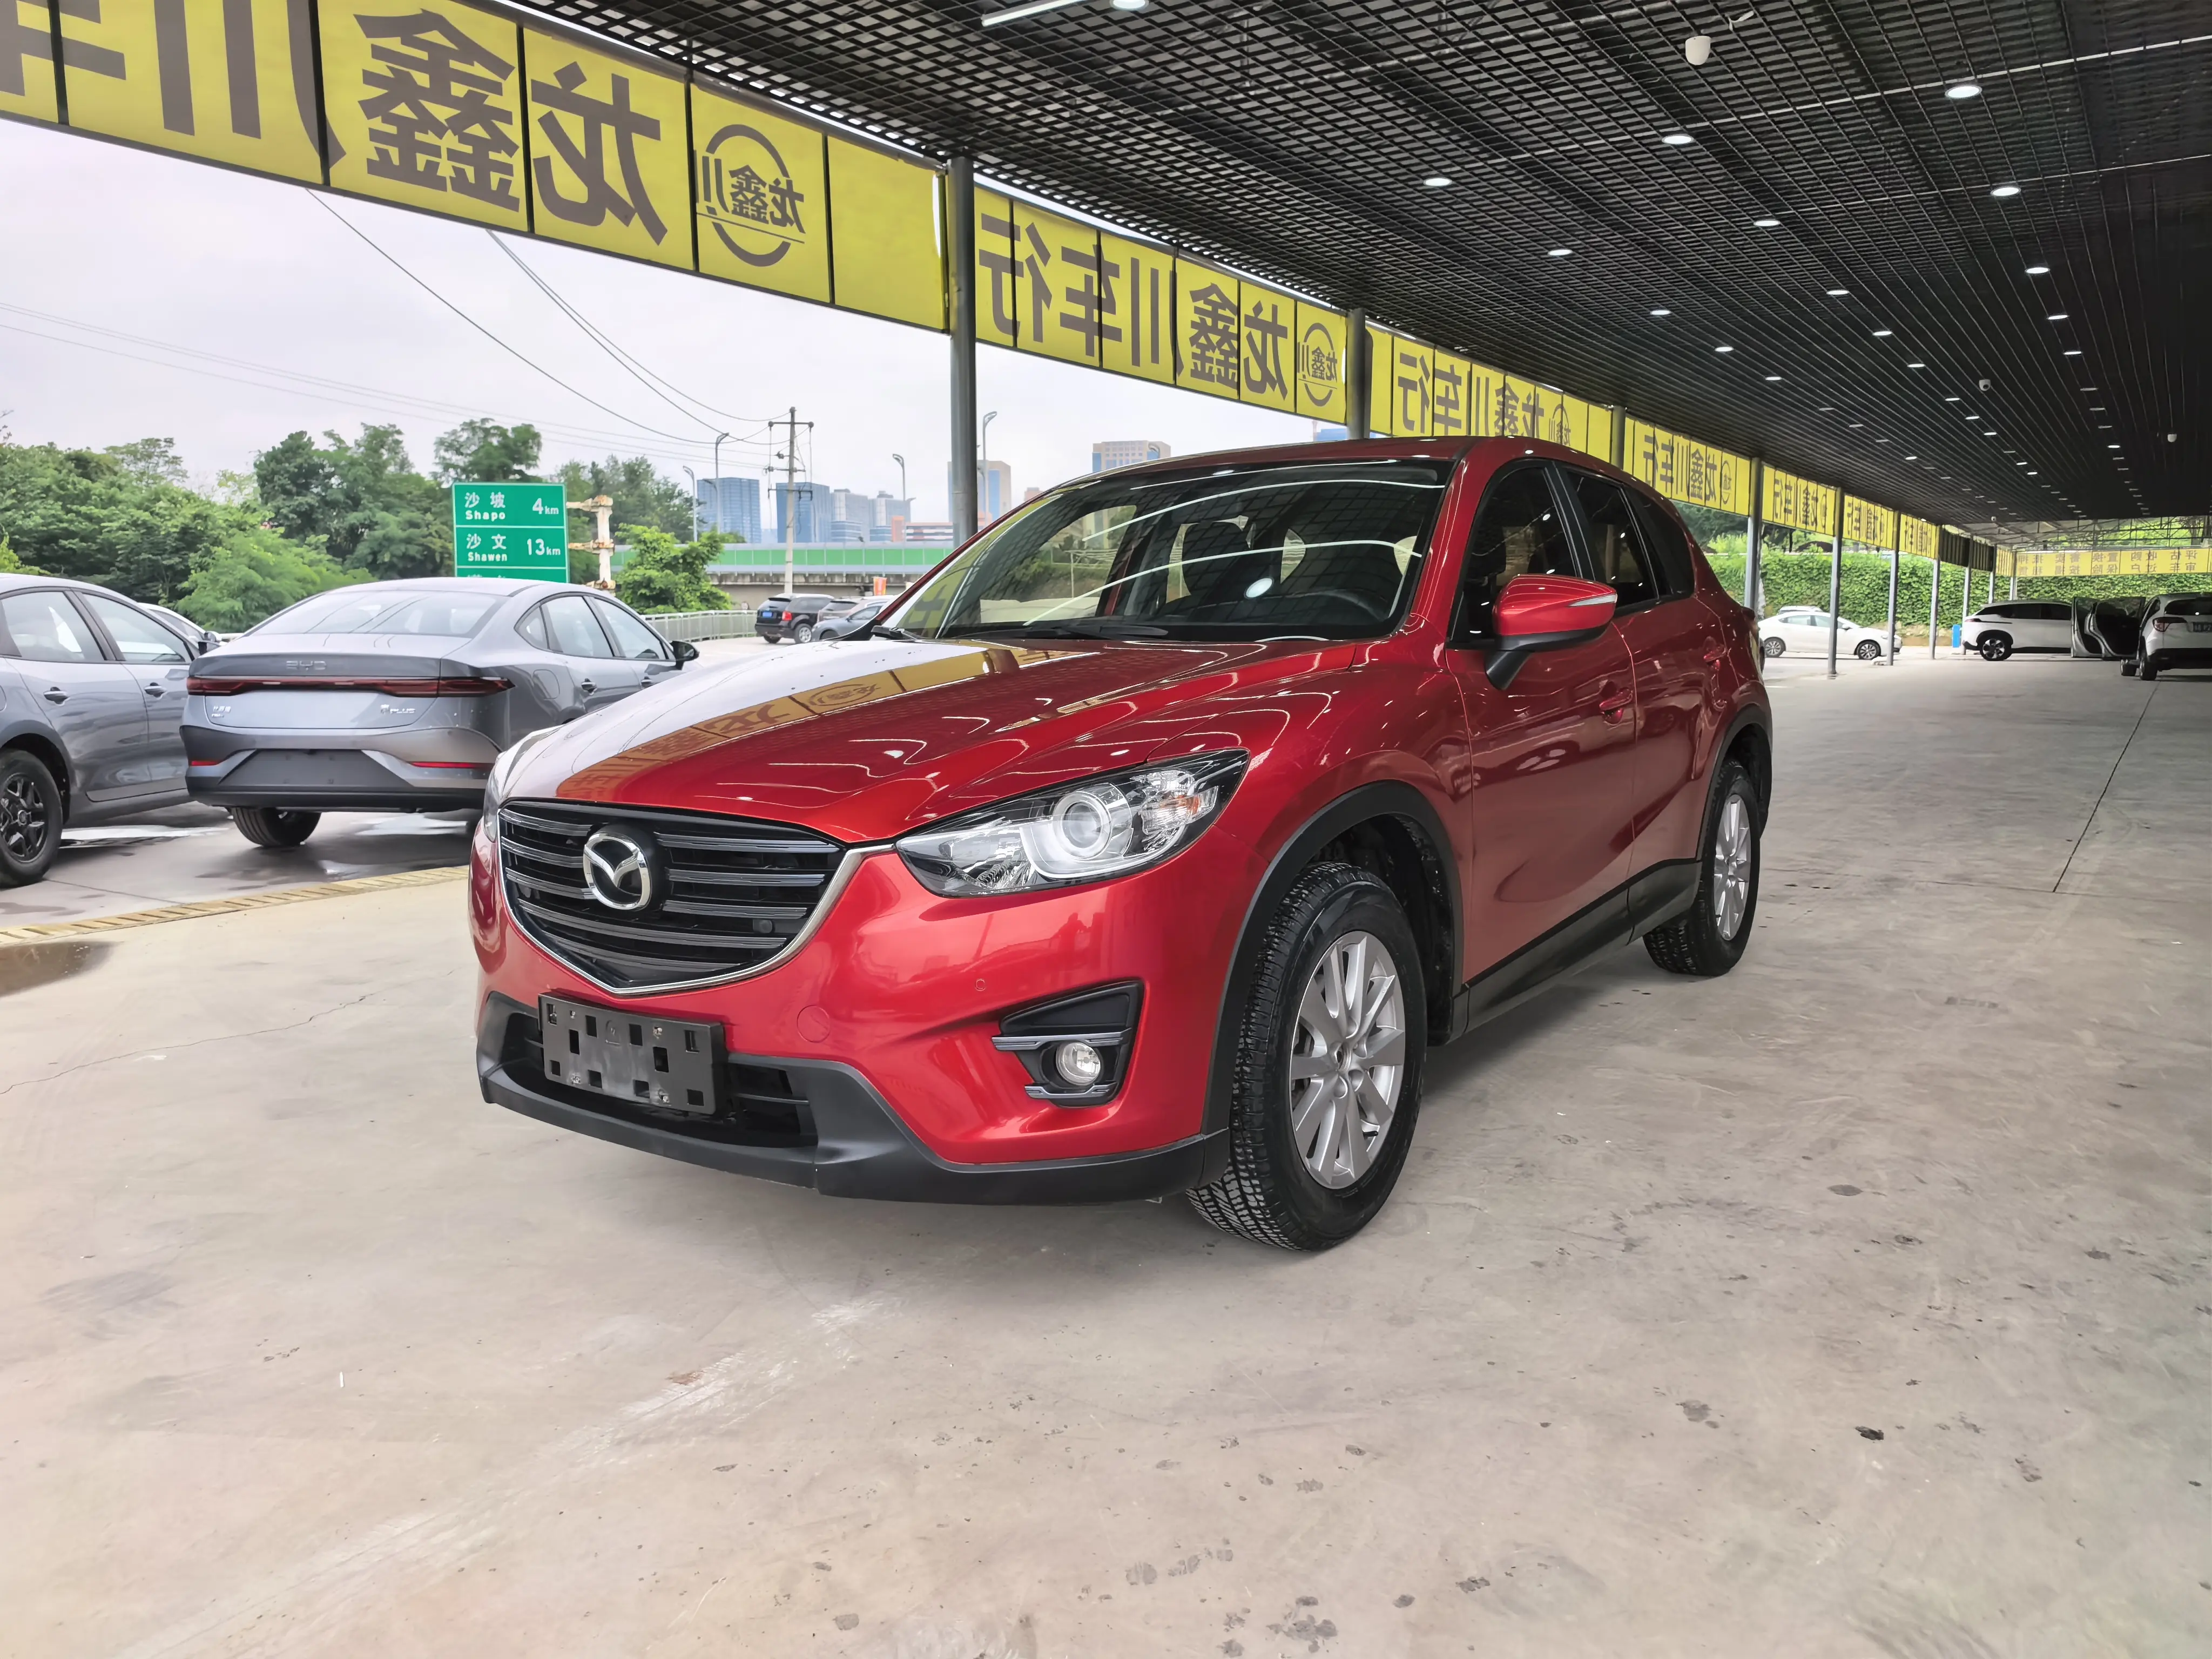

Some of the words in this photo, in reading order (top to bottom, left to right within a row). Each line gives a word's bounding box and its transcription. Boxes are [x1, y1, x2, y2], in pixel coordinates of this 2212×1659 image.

[464, 491, 506, 508] 沙坡
[465, 510, 506, 522] Shapo
[466, 533, 507, 550] 沙文
[468, 551, 508, 562] Shawen
[286, 660, 327, 671] BYD
